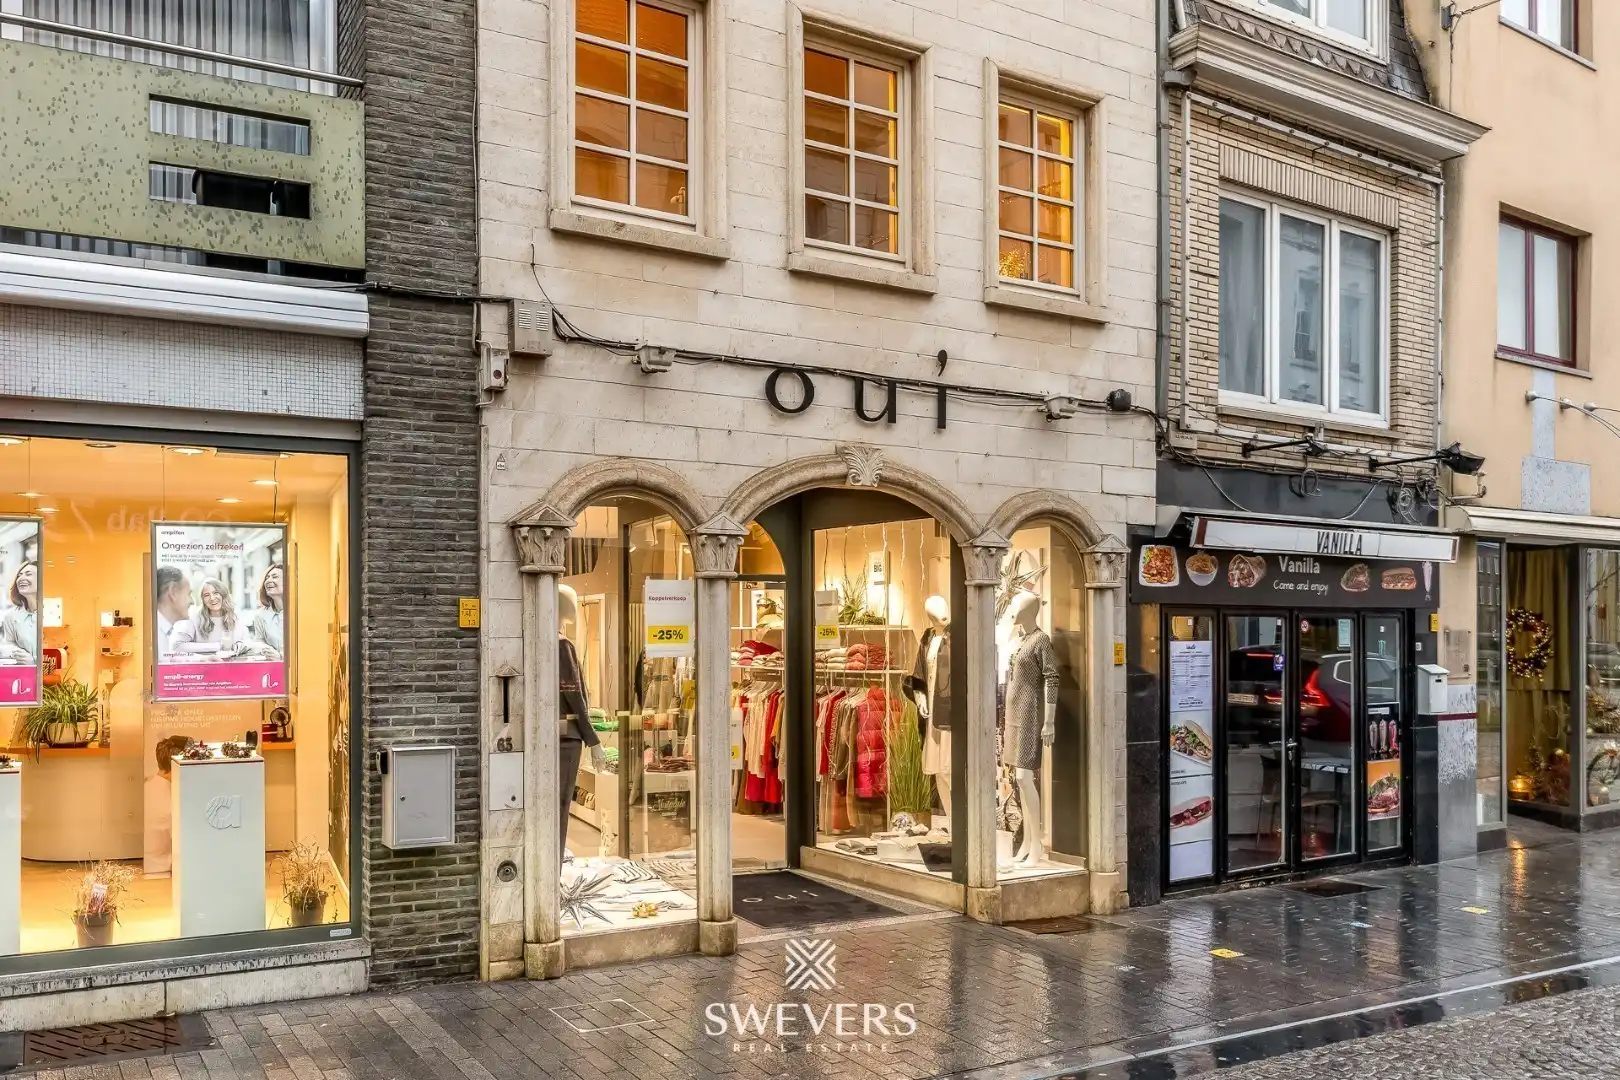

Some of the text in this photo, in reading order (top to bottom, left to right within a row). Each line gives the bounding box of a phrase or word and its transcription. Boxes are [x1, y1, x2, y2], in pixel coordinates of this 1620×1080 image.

[161, 541, 204, 551] Ongezien
[1316, 531, 1362, 556] VANILLA
[1278, 556, 1320, 574] Vanilla
[1273, 579, 1329, 596] Come and enjoy
[653, 629, 684, 640] -25%
